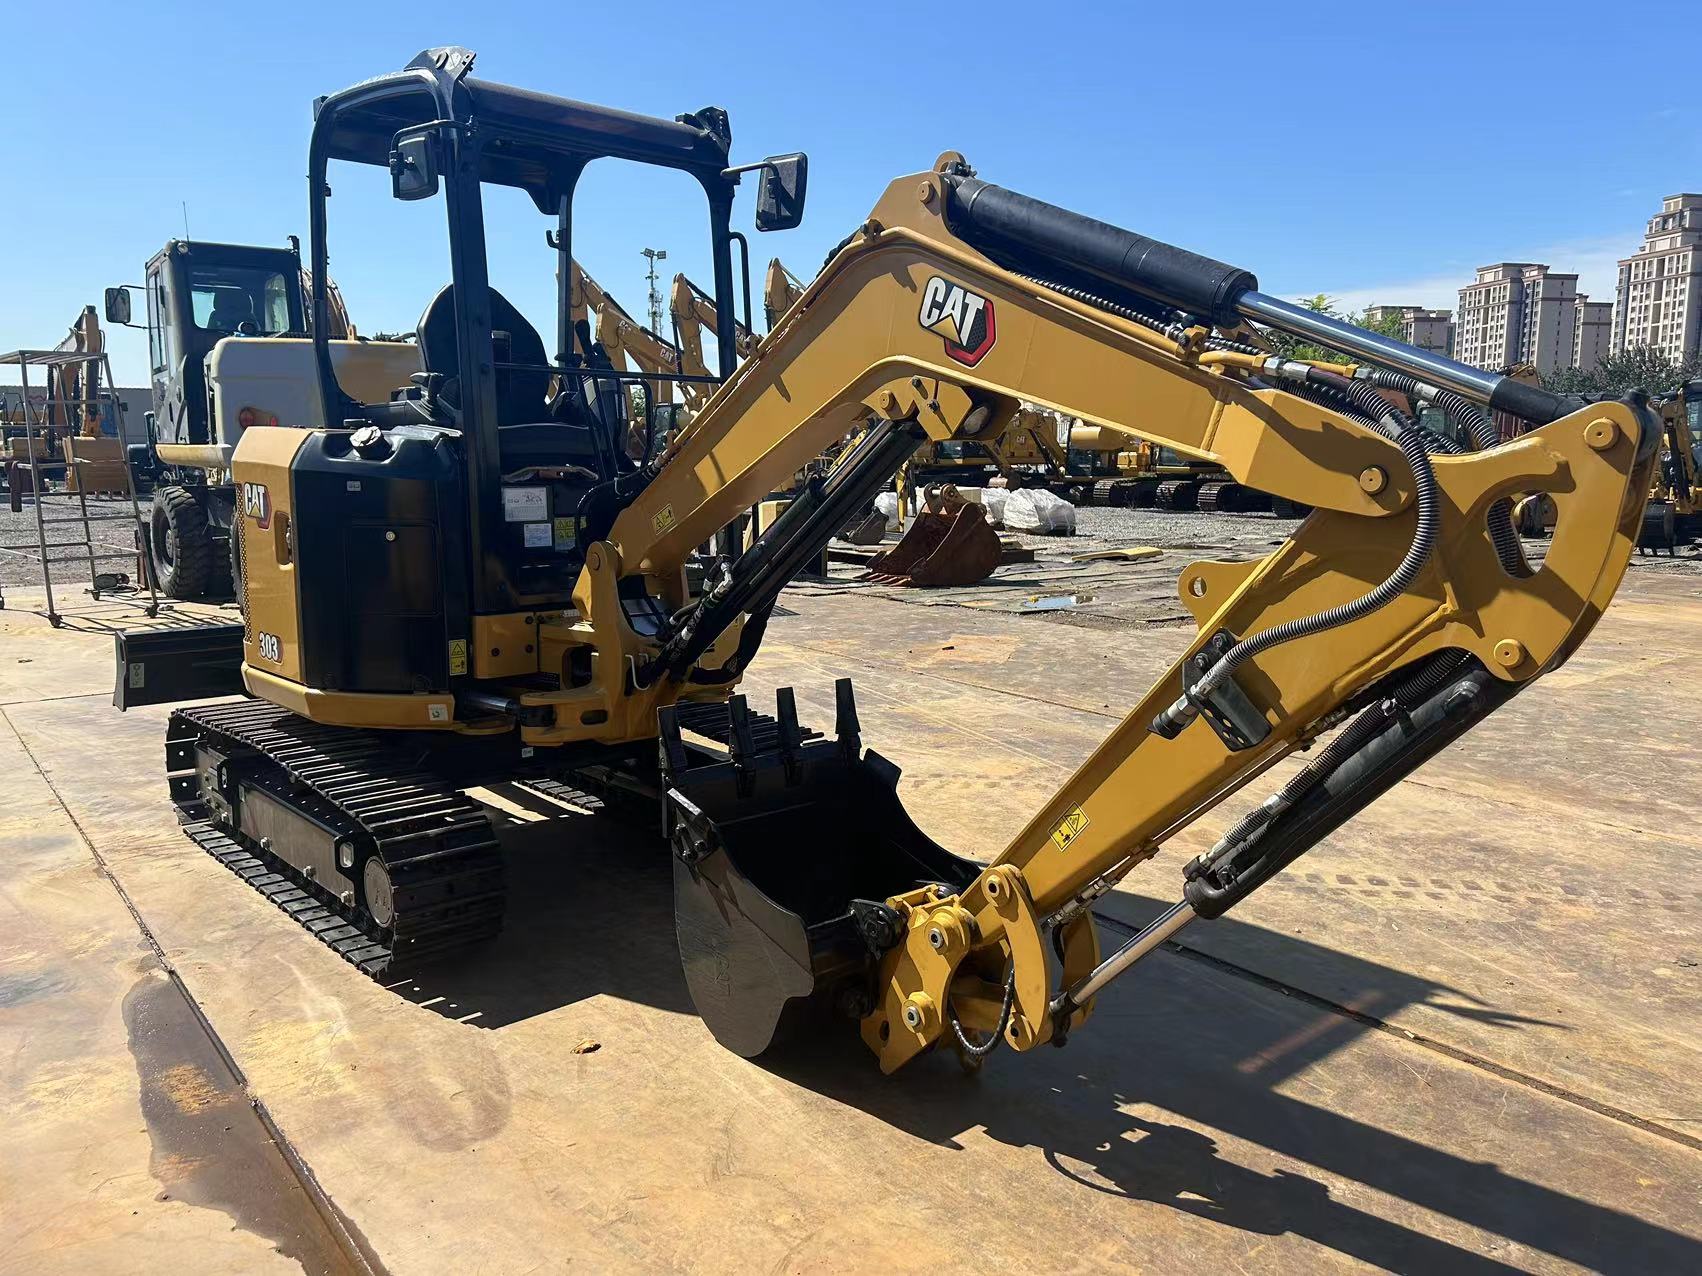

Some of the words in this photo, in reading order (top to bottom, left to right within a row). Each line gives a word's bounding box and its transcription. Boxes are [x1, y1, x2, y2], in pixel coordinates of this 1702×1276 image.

[920, 277, 985, 347] CAT
[660, 348, 674, 363] CAT
[244, 483, 265, 519] CAT
[259, 632, 279, 661] 303
